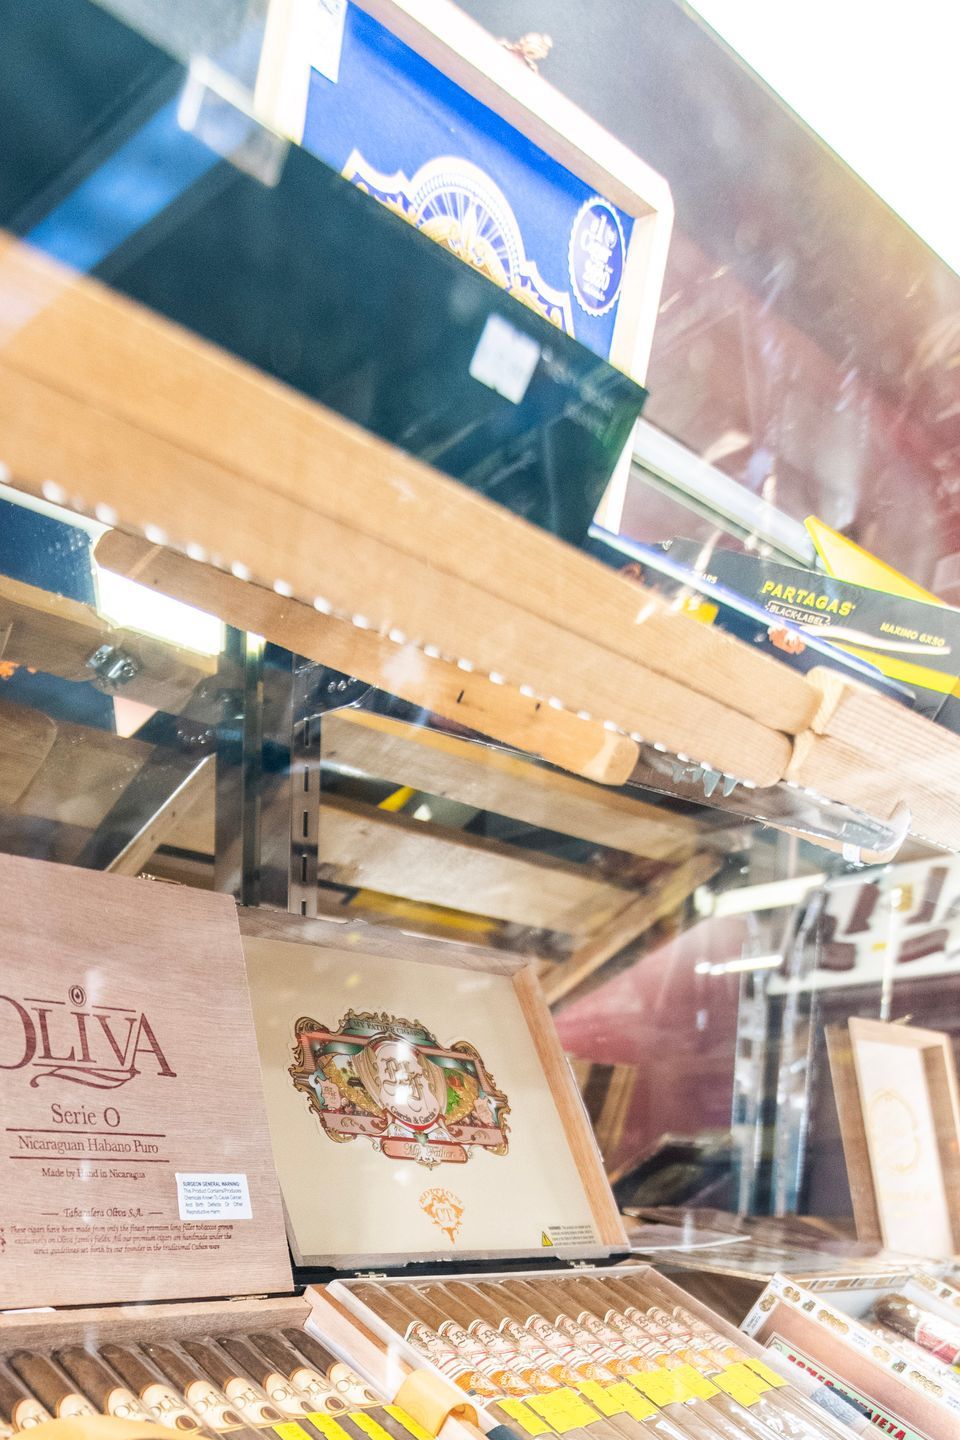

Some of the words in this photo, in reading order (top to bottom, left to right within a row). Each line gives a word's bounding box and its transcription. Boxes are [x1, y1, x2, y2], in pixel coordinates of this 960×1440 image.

[760, 580, 853, 617] PARTAGAS
[879, 621, 919, 641] MAXIMO
[50, 1102, 97, 1126] Serie
[103, 1106, 121, 1128] O
[18, 1135, 85, 1155] Nicaraguan
[87, 1138, 132, 1154] Habano
[133, 1140, 159, 1154] Puro
[41, 1167, 65, 1178] Made
[66, 1167, 76, 1179] by
[100, 1168, 108, 1178] in
[109, 1168, 146, 1181] Nicaragua
